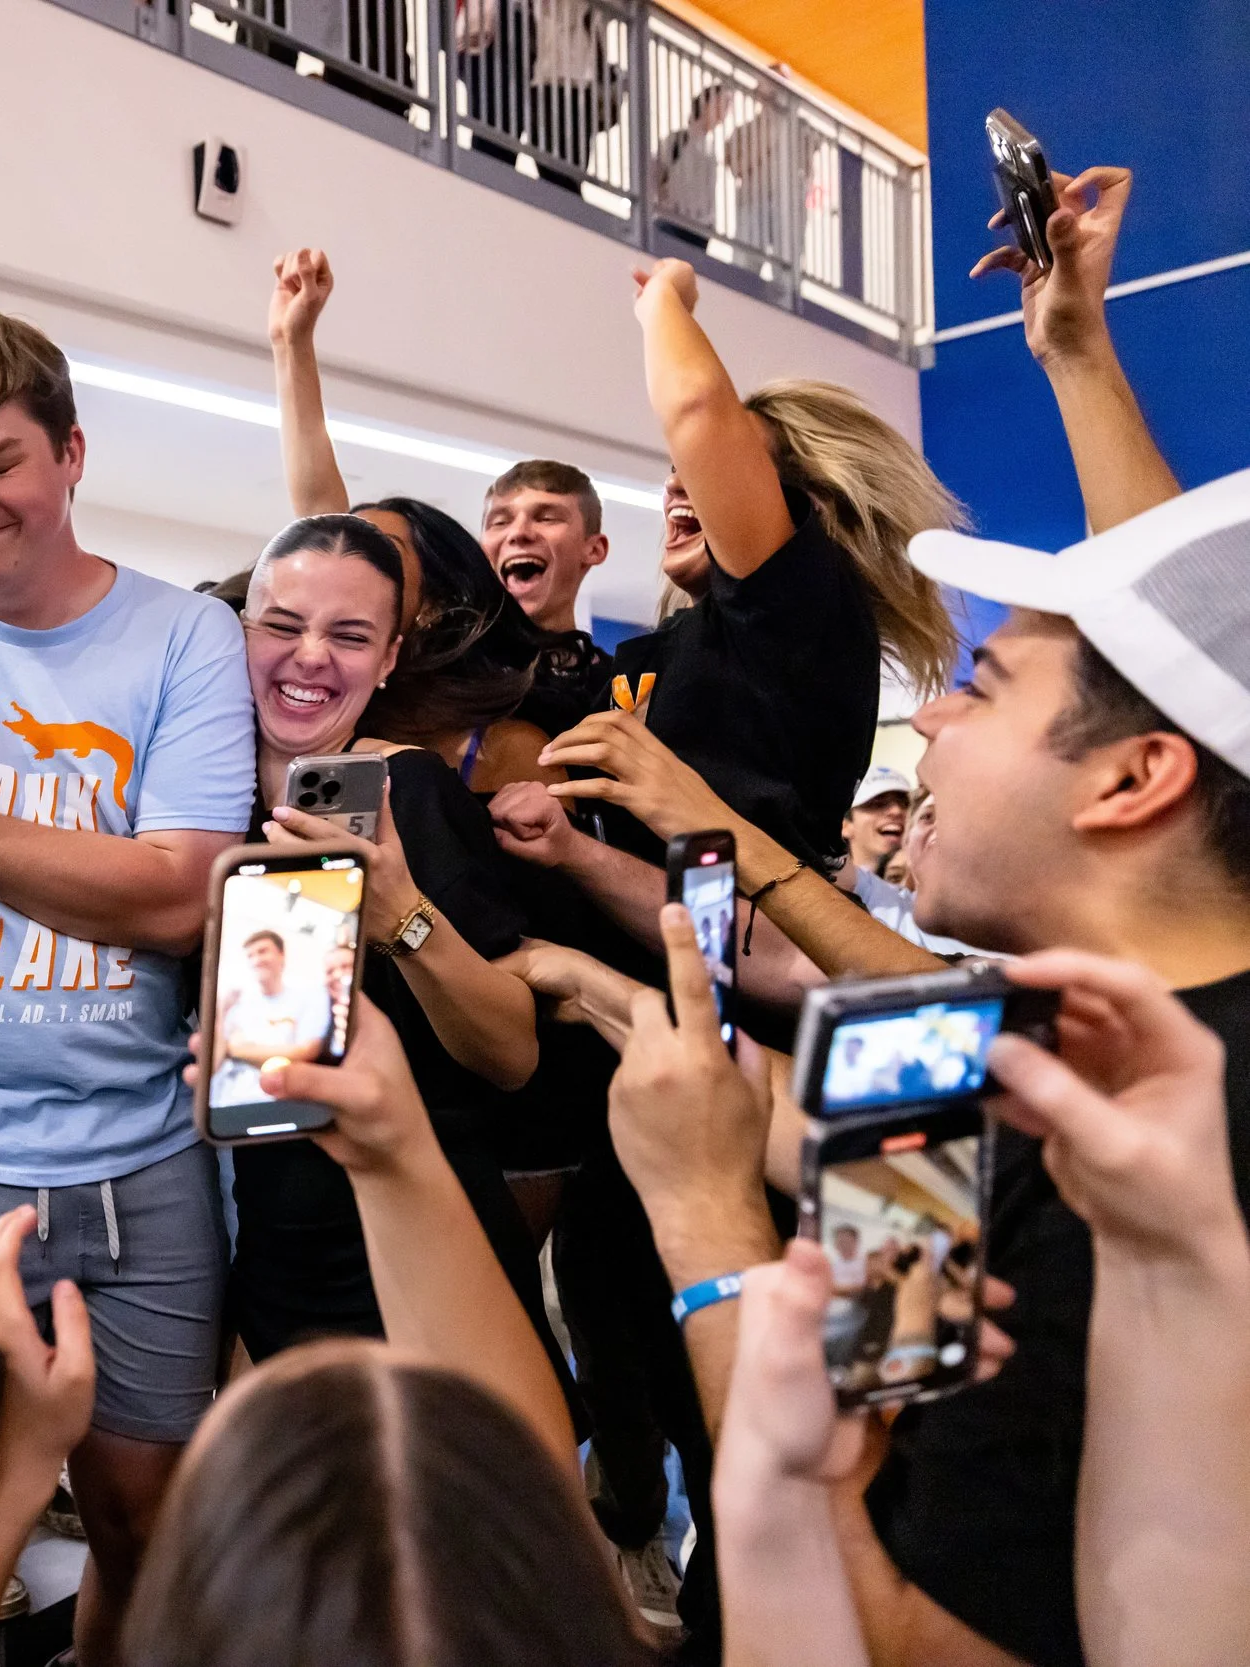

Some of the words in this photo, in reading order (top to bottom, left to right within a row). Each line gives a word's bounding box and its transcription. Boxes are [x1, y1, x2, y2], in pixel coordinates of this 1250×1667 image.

[19, 1004, 51, 1024] AD.
[60, 1004, 74, 1023] T.
[79, 1001, 133, 1023] SMACK
